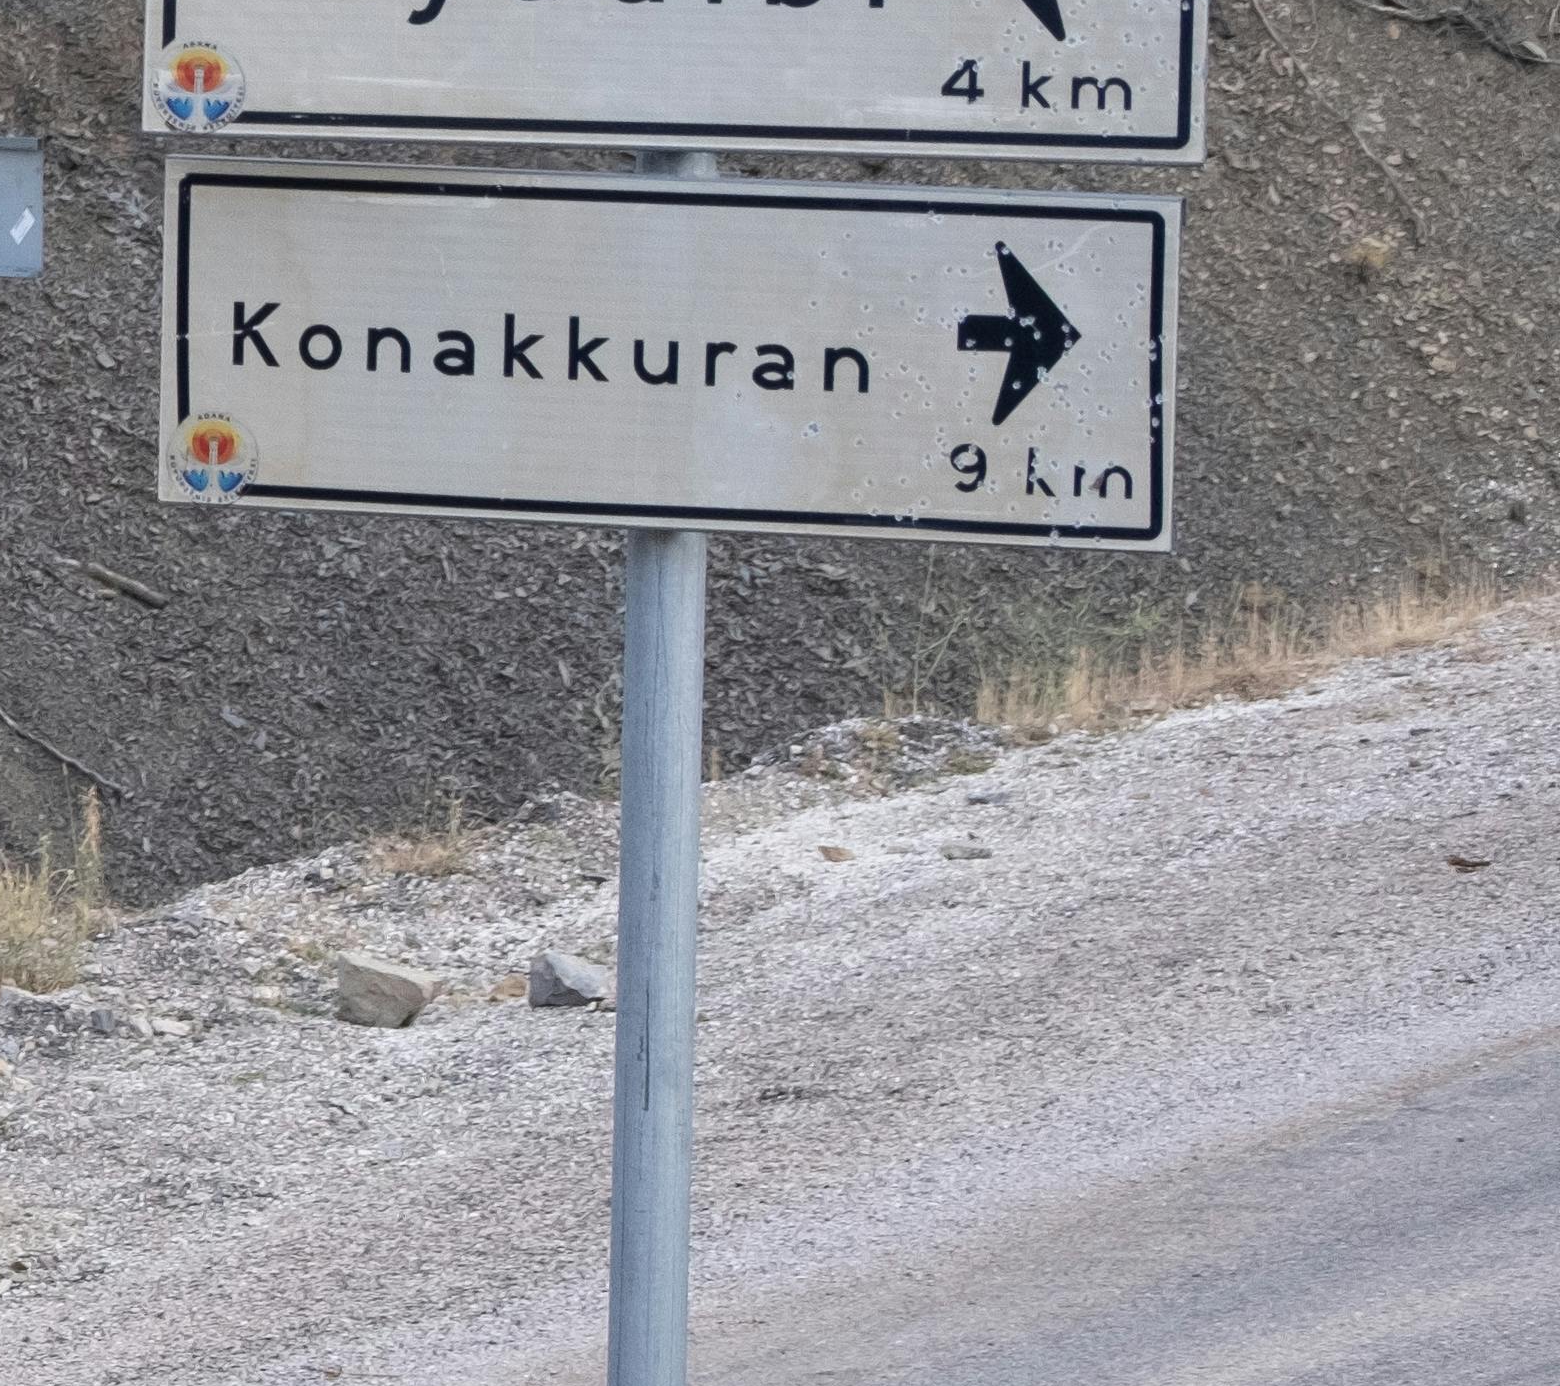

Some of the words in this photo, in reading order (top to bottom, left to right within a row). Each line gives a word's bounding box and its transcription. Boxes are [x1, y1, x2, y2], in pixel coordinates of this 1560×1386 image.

[940, 58, 986, 104] 4
[1020, 59, 1133, 112] km
[231, 300, 871, 395] Konakkuran
[949, 442, 988, 494] 9
